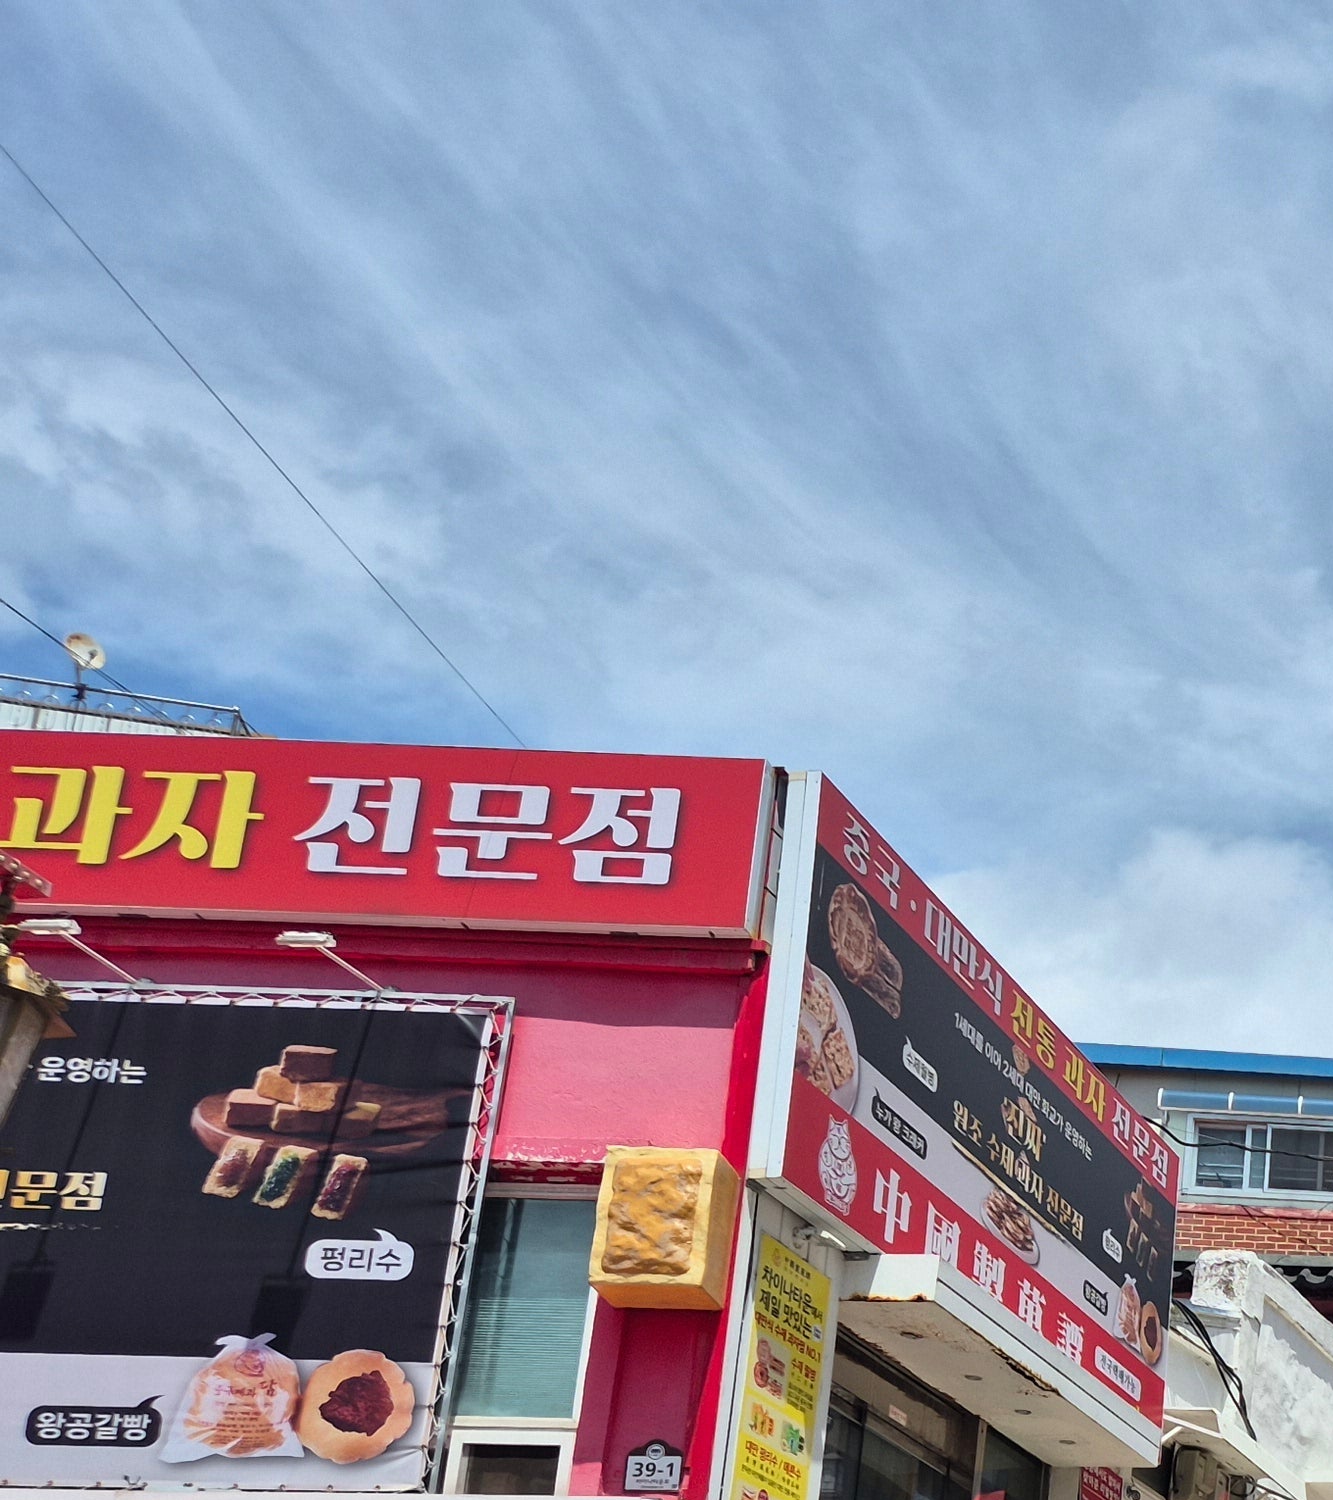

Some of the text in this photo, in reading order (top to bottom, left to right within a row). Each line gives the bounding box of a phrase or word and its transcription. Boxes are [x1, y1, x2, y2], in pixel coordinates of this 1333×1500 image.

[0, 765, 681, 885] 과자 전문점
[37, 1056, 148, 1084] 운영하는
[1011, 988, 1057, 1069] 전통
[1062, 1041, 1105, 1123] 과자
[1111, 1097, 1168, 1189] 전문점
[985, 1040, 1002, 1067] 이어
[1002, 1061, 1025, 1093] 2세대
[1025, 1080, 1041, 1108] 대만
[1064, 1119, 1093, 1162] 운영하는
[953, 1099, 983, 1147] 원조
[1046, 1186, 1084, 1241] 전문점
[319, 1245, 403, 1274] 펑리수
[760, 1289, 781, 1319] 제일
[783, 1303, 812, 1340] 맛있는
[35, 1413, 152, 1441] 왕공갈빵
[632, 1462, 674, 1477] 39-1
